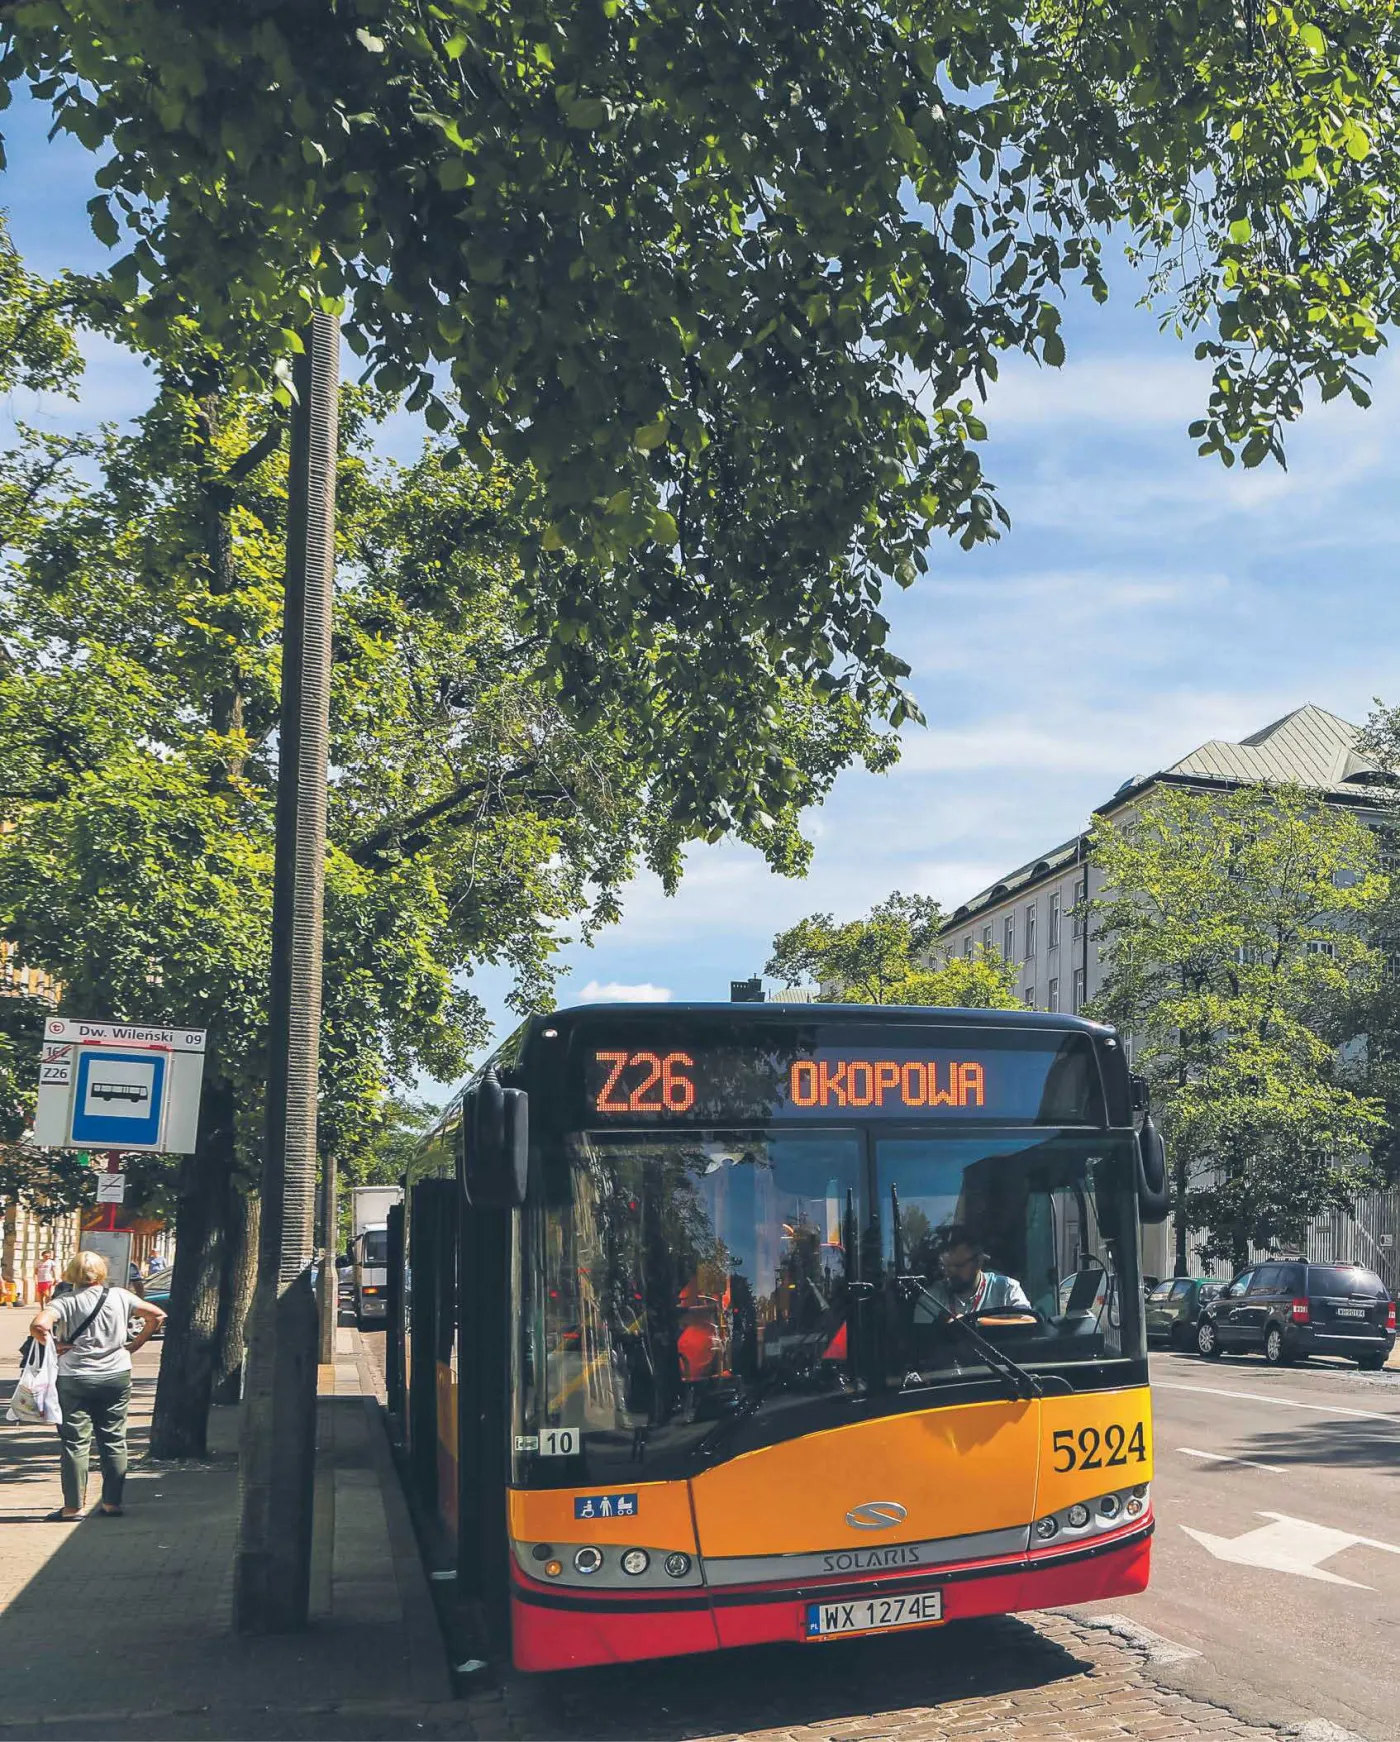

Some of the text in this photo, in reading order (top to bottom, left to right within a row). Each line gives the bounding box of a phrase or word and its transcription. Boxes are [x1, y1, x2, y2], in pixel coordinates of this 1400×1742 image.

[79, 1025, 202, 1045] Dw. Wileński 09
[43, 1066, 68, 1079] Z26
[596, 1052, 694, 1111] Z26
[791, 1061, 984, 1106] OKOPOWA
[547, 1431, 573, 1454] 10
[1053, 1422, 1146, 1473] 5224
[823, 1546, 920, 1573] SOLARIS
[825, 1595, 936, 1630] WX 1274E
